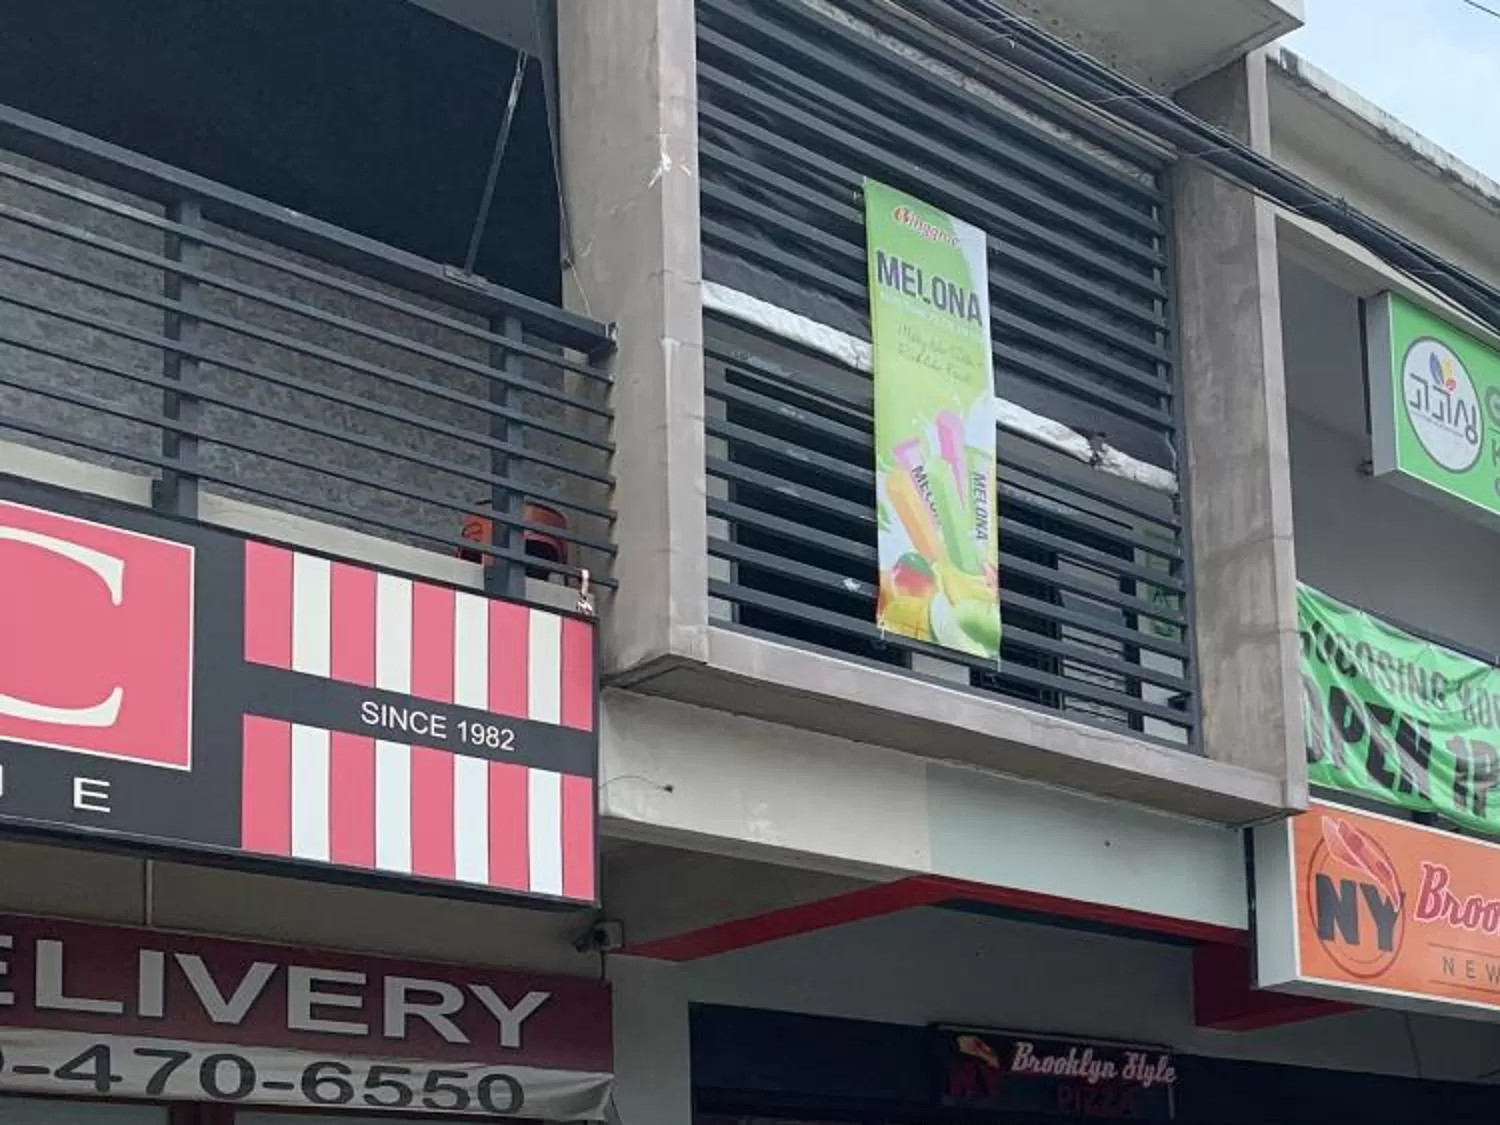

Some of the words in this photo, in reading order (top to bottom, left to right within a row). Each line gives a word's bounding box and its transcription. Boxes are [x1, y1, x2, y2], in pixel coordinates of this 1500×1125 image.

[876, 249, 984, 329] MELONA
[974, 471, 989, 541] MELONA
[360, 700, 449, 741] SINCE
[456, 719, 516, 753] 1982
[1314, 873, 1403, 953] NY
[0, 934, 552, 1050] LIVERY
[0, 1042, 526, 1115] -470-6550
[1010, 1040, 1119, 1085] Brooklyn
[1122, 1050, 1177, 1088] Style
